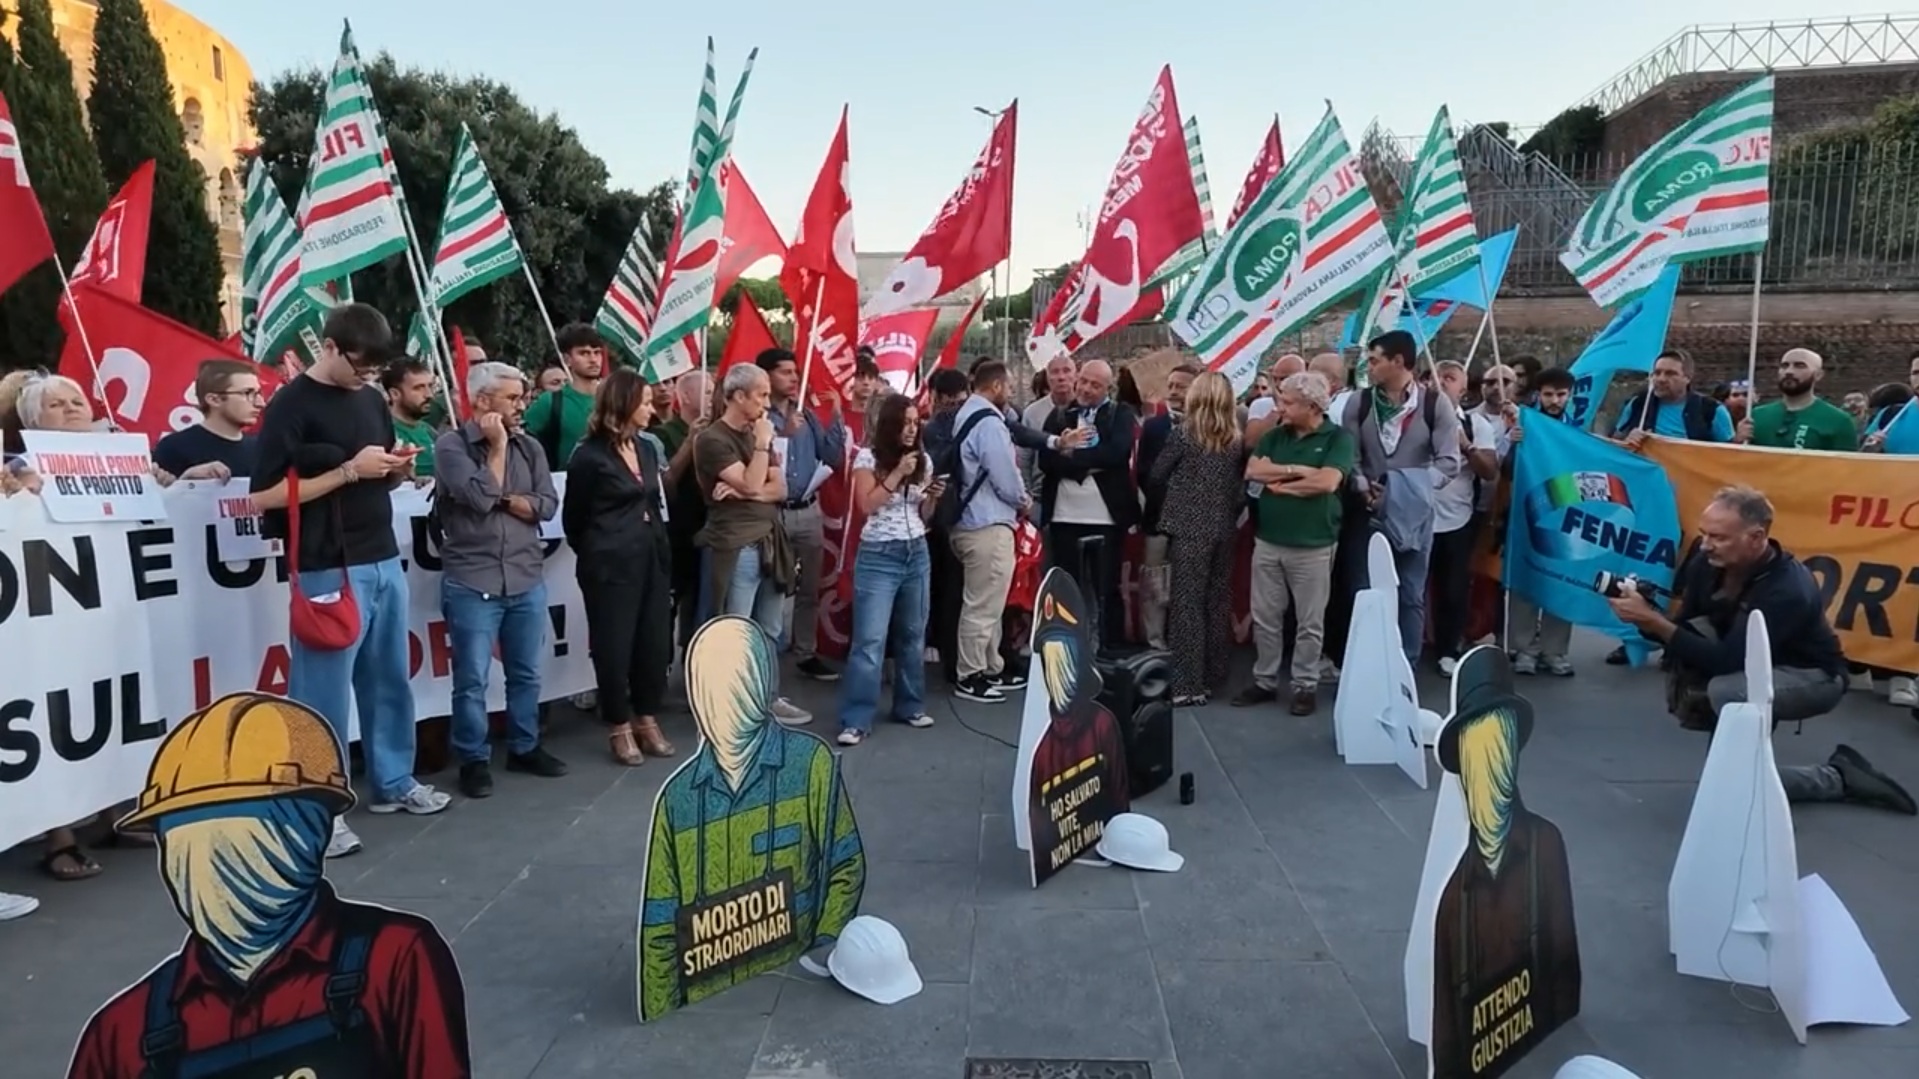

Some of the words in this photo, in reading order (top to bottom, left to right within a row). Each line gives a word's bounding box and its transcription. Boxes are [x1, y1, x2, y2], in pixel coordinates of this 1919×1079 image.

[36, 452, 106, 475] L'UMANITÀ
[105, 455, 151, 474] PRIMA
[55, 475, 83, 495] DEL
[82, 475, 143, 495] PROFITTO
[235, 517, 256, 536] DEL
[1560, 506, 1676, 569] FENEA
[0, 671, 168, 784] SUL
[1050, 797, 1065, 822] HO
[1064, 775, 1101, 812] SALVATO
[1050, 840, 1072, 870] NON
[1071, 832, 1084, 855] LA
[683, 910, 791, 977] STRAORDINARI
[692, 890, 763, 944] MORTO
[765, 881, 785, 915] DI
[1472, 968, 1531, 1036] ATTENDO
[1470, 1003, 1534, 1074] GIUSTIZIA
